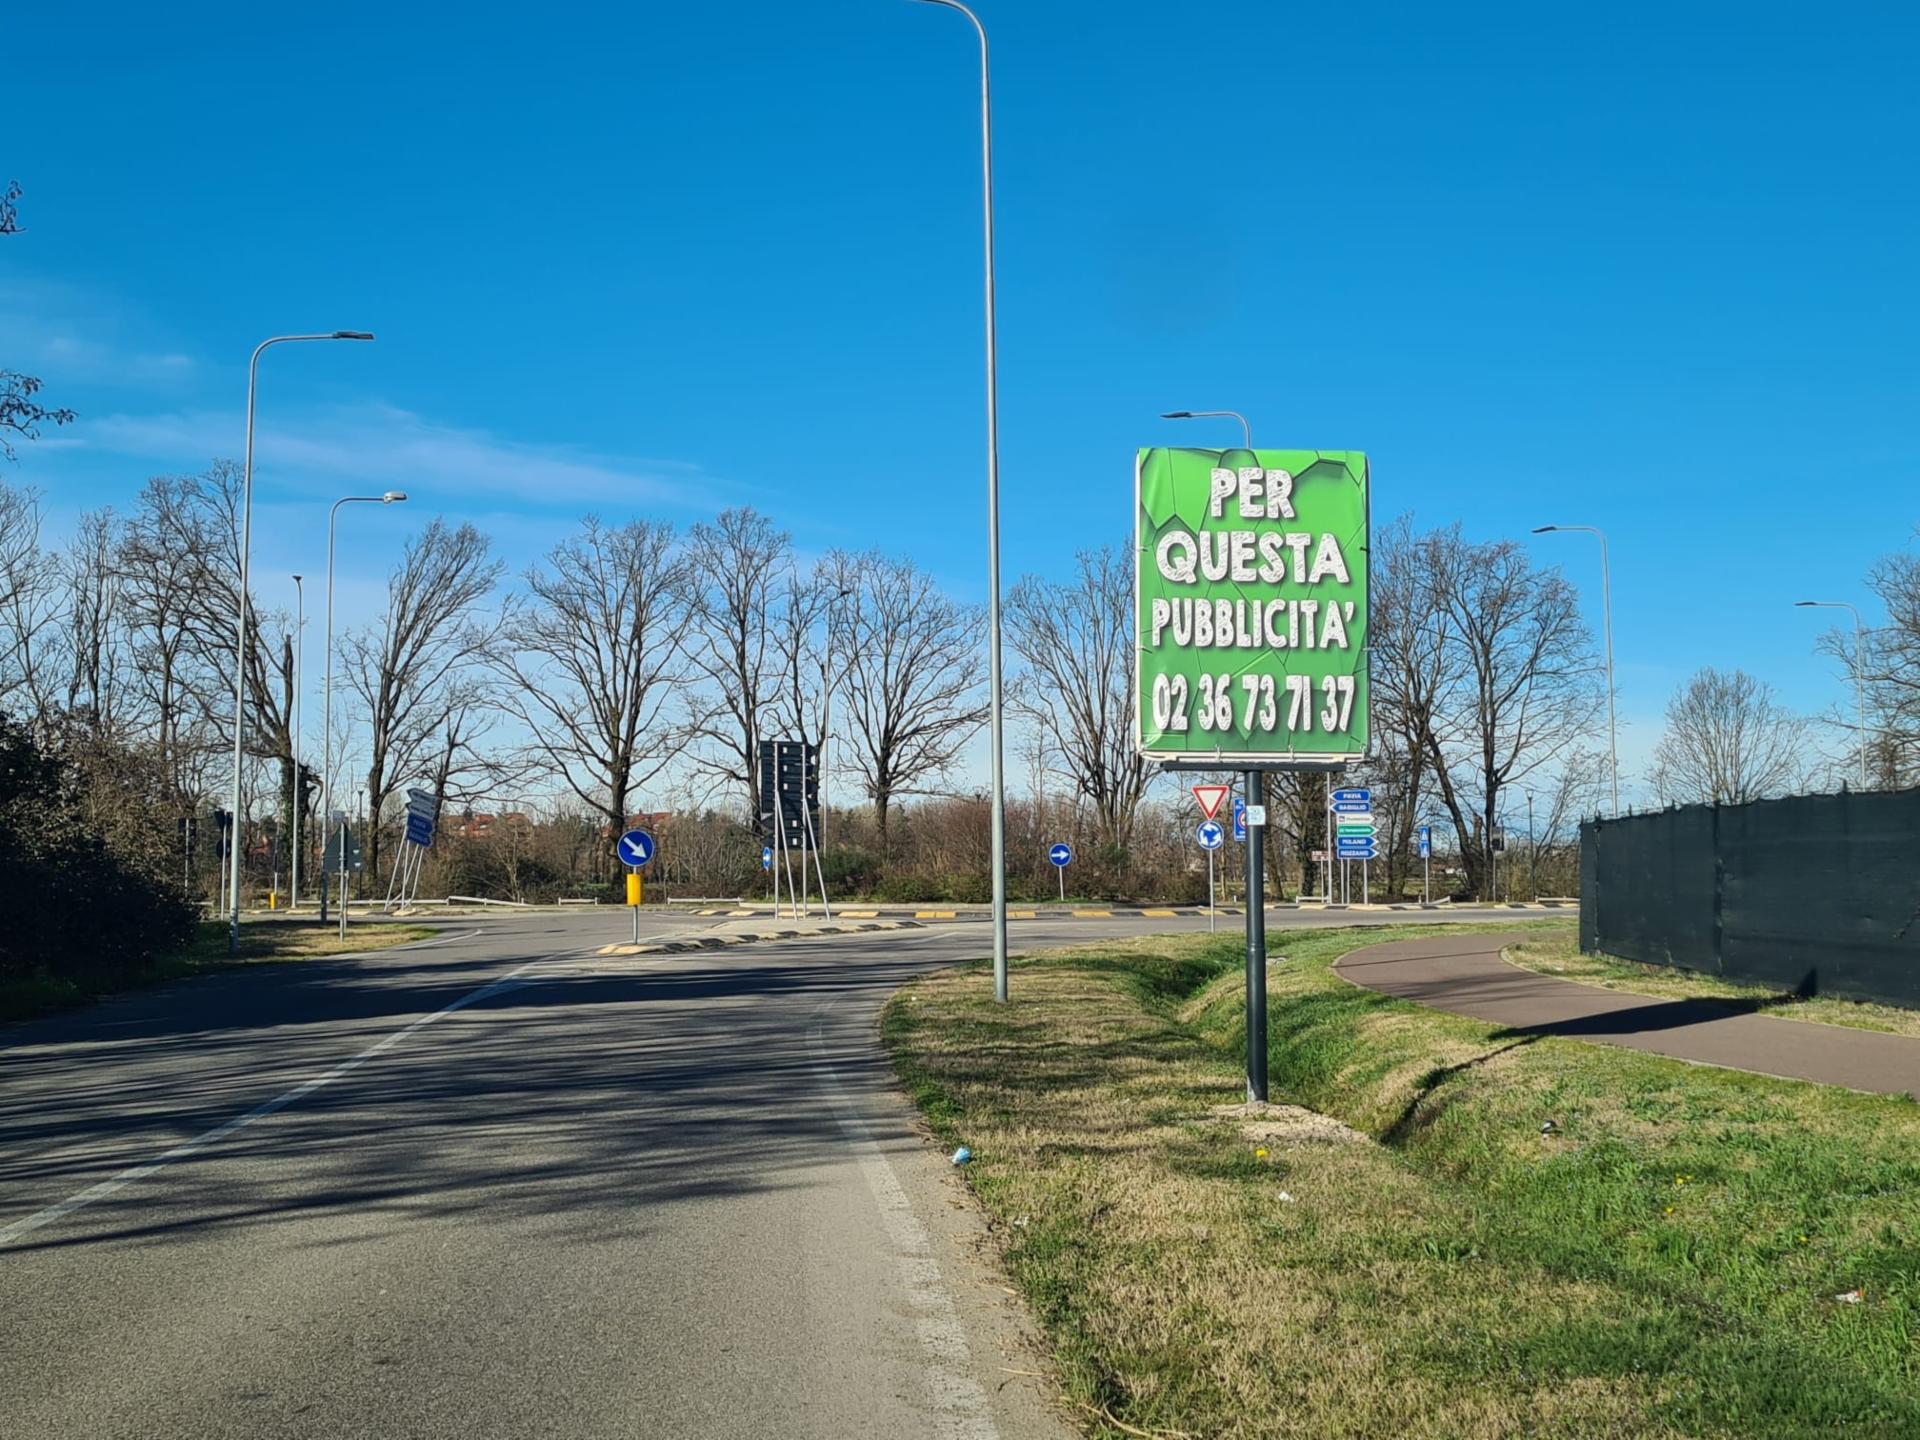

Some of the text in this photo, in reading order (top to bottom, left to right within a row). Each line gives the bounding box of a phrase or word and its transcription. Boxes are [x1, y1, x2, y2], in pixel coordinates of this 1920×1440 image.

[1210, 467, 1295, 518] PER
[1155, 531, 1350, 584] QUESTA
[1152, 598, 1354, 648] PUBBLICITA'
[1152, 673, 1355, 732] 02 36 73 71 37
